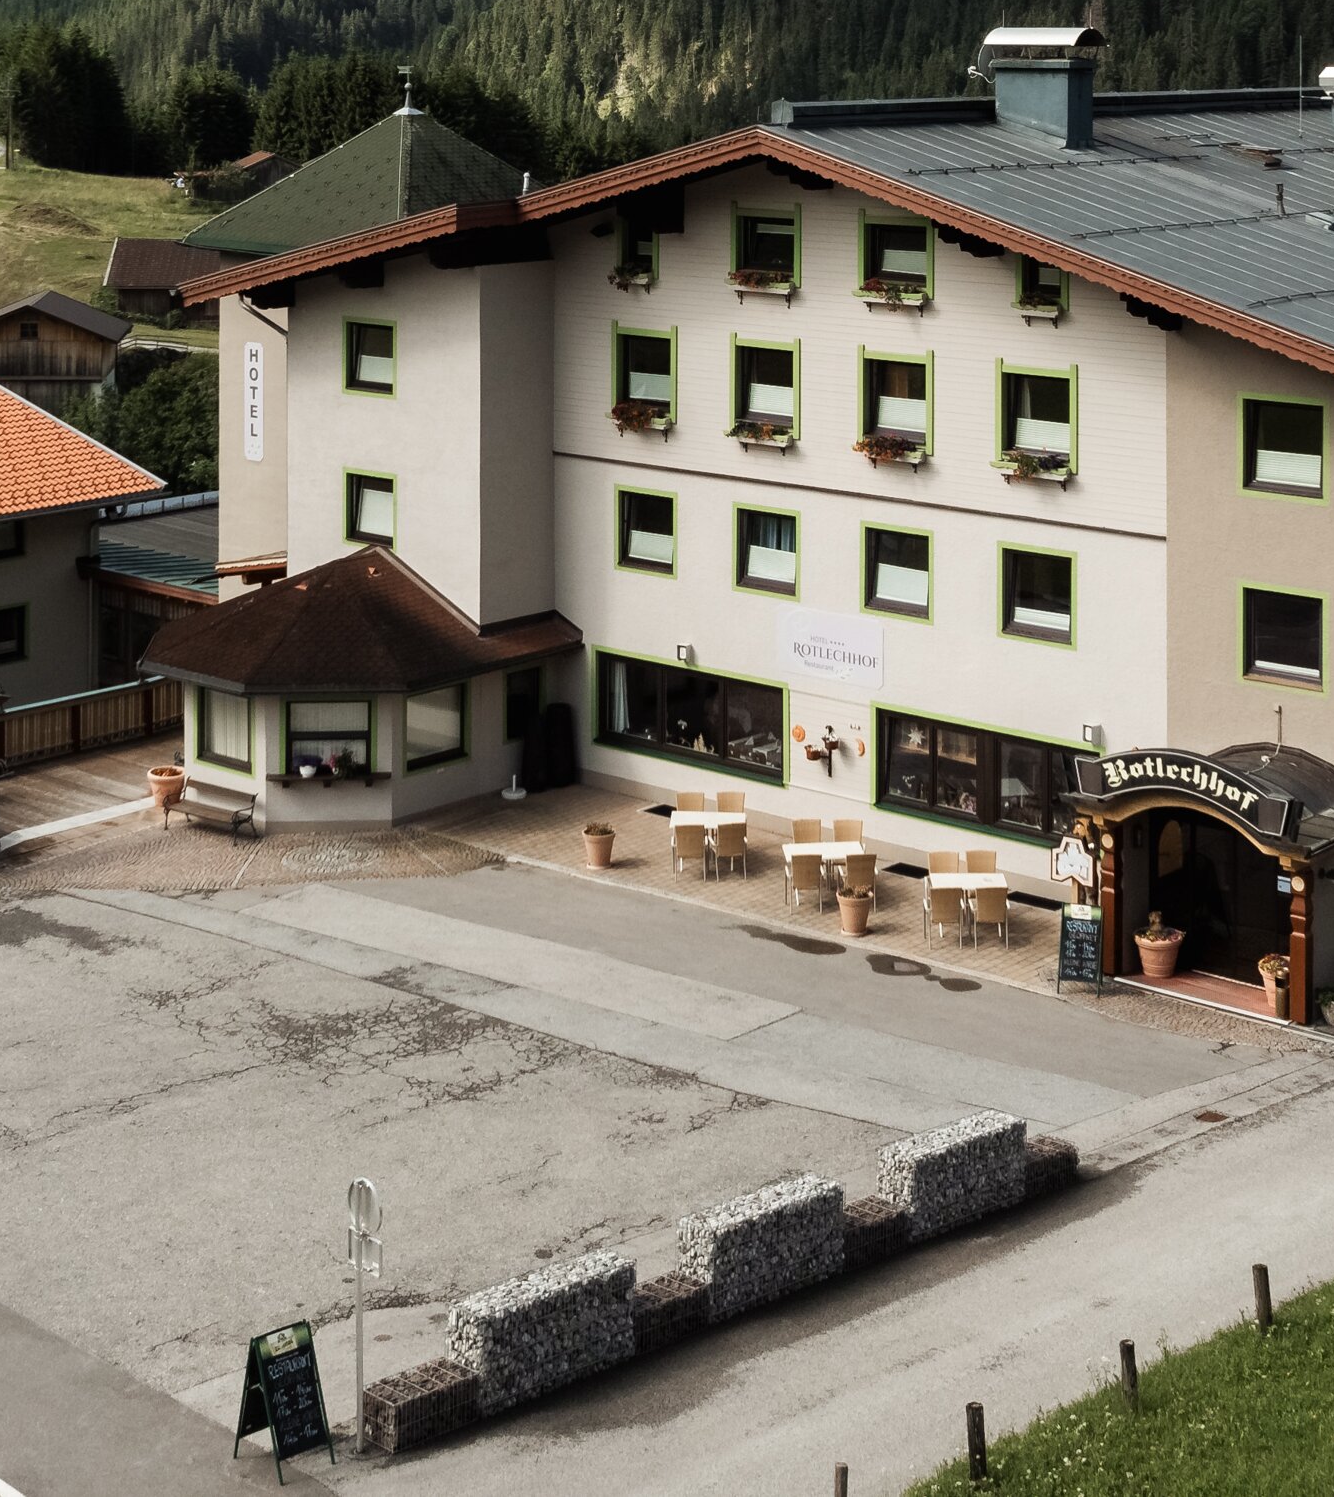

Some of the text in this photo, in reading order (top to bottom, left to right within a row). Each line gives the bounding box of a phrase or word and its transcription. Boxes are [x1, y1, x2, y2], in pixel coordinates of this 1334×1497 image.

[249, 348, 259, 437] HOTEL
[810, 635, 828, 645] HOTEL
[793, 641, 879, 669] ROTLECHHOF
[803, 659, 835, 672] Restaurant
[1101, 756, 1260, 812] Rotlechhof
